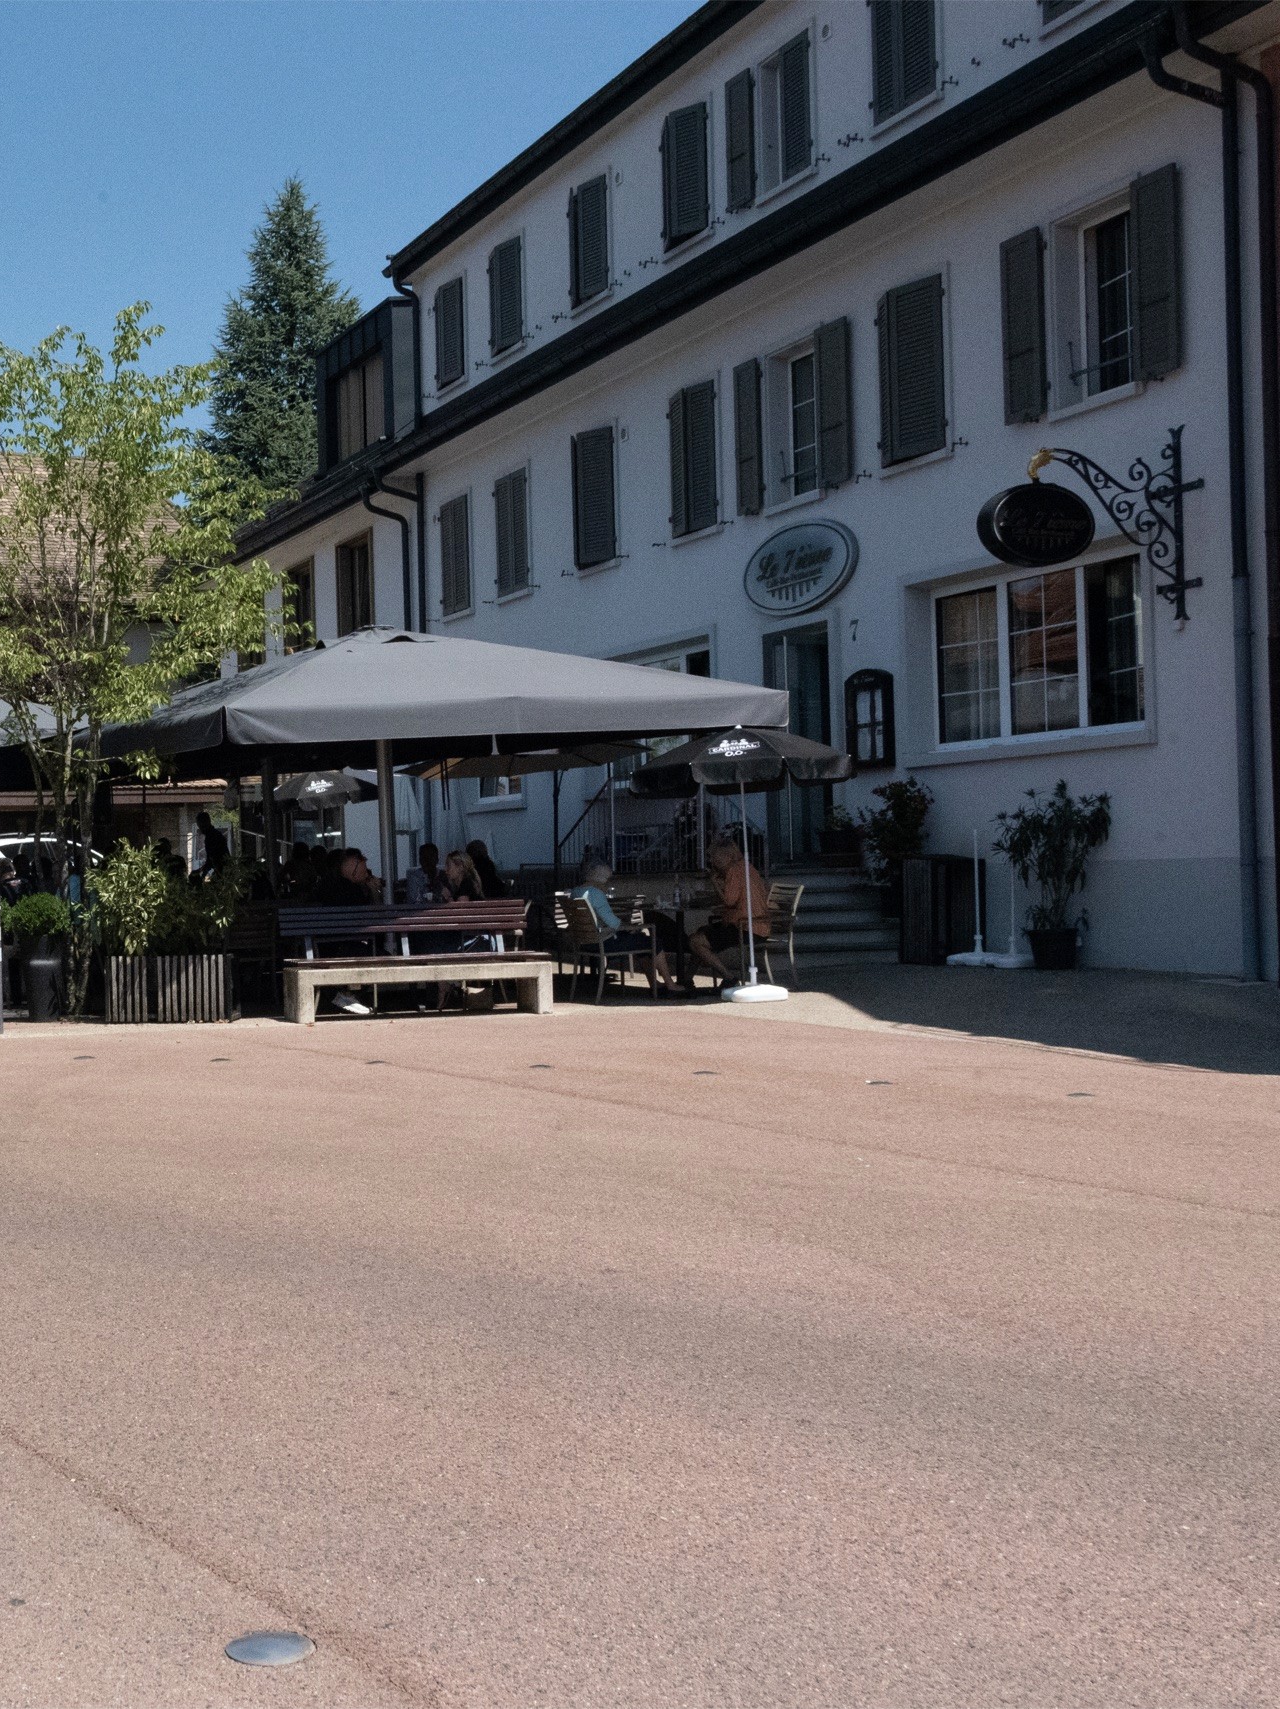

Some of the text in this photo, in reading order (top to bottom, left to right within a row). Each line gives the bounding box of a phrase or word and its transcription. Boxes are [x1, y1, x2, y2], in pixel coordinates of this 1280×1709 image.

[756, 552, 780, 582] Le
[849, 619, 859, 641] 7
[712, 743, 757, 753] CARDINAL
